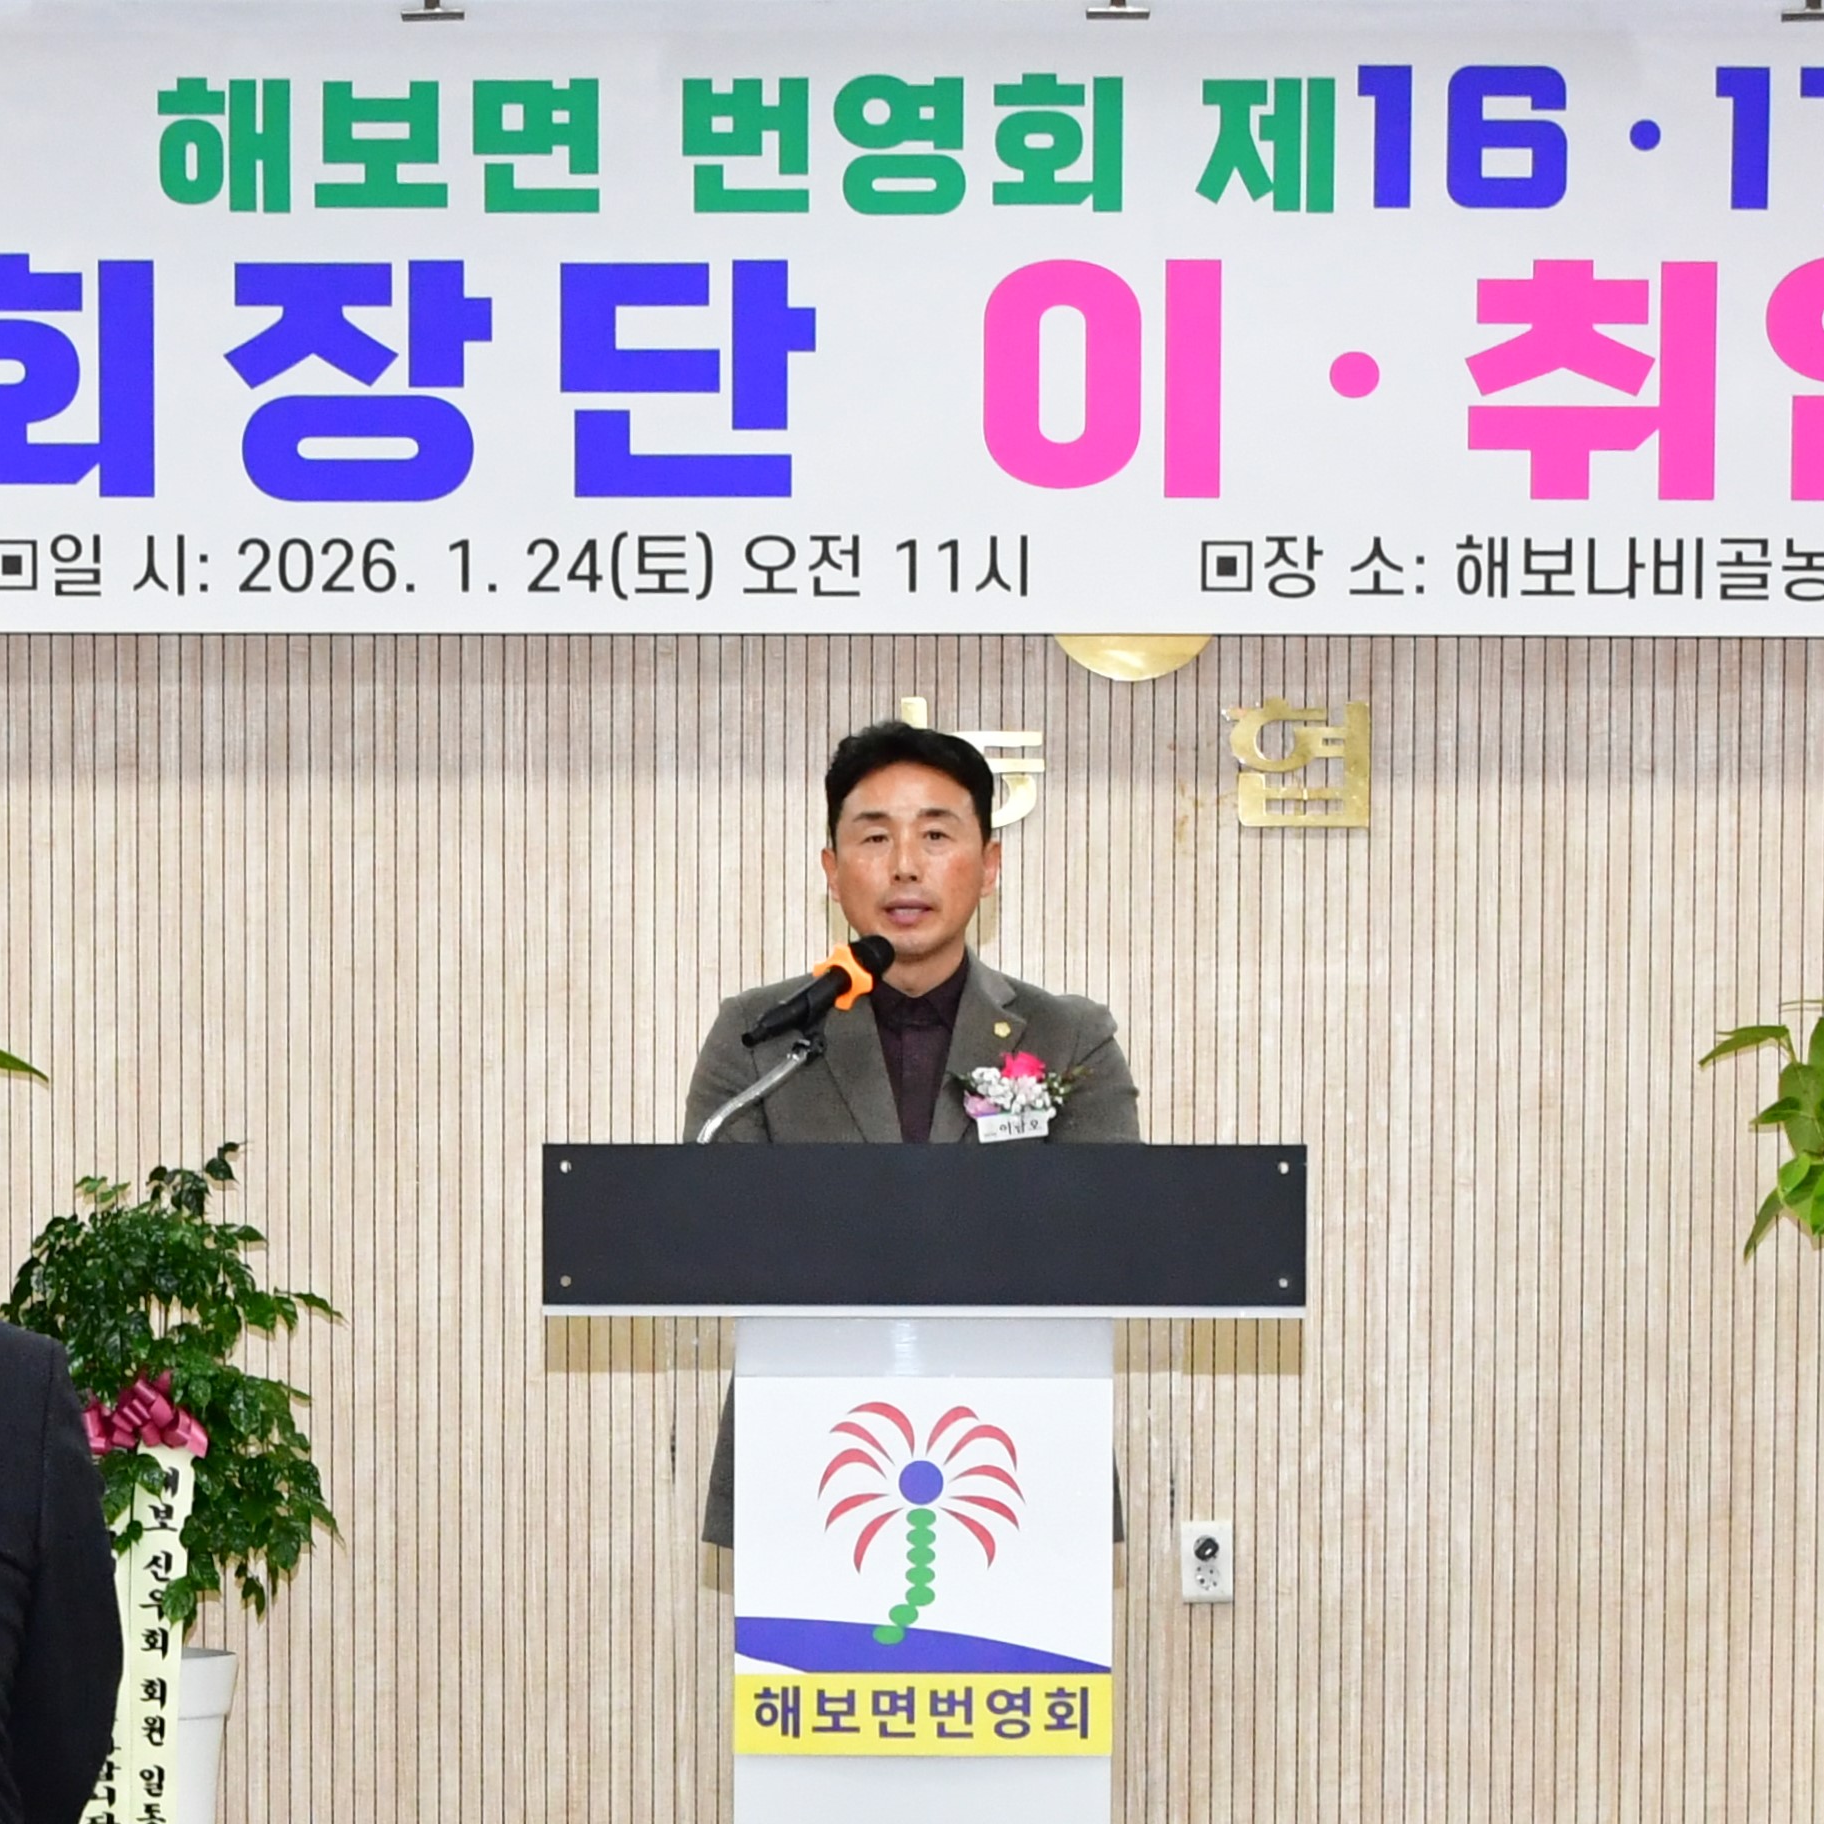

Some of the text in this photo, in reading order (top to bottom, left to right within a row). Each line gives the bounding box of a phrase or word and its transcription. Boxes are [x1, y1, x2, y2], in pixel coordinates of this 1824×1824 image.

[159, 78, 599, 212] 해보면
[683, 74, 1122, 214] 번영회
[134, 535, 207, 595] 시:
[239, 539, 414, 592] 2026.
[450, 540, 496, 591] 1.
[528, 532, 712, 599] 24(토)
[744, 535, 859, 596] 오전
[897, 536, 1027, 596] 11시
[1350, 537, 1424, 594] 소:
[139, 1677, 168, 1746] 회원
[754, 1686, 1088, 1739] 해보면번영회
